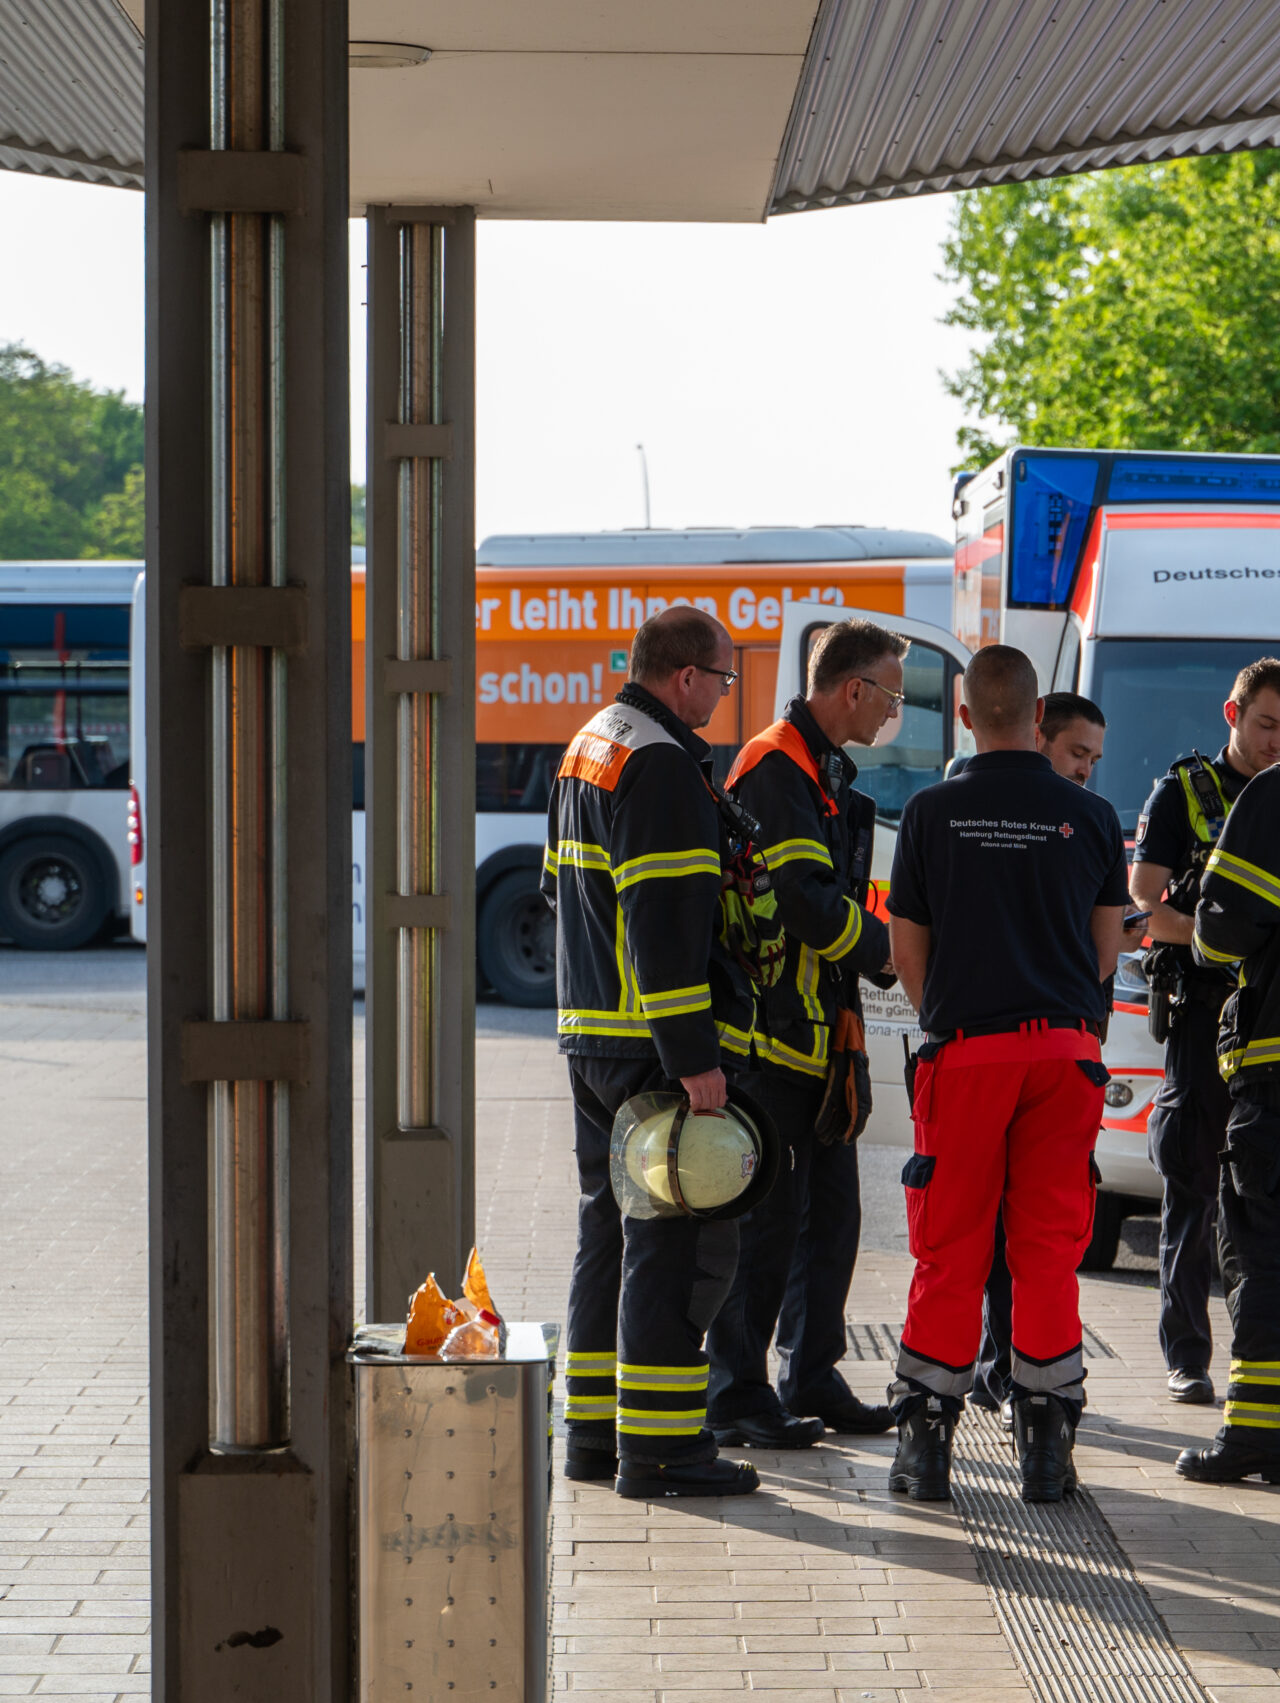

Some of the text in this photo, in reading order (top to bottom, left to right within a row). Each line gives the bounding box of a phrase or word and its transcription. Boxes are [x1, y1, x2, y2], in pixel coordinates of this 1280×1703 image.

[510, 588, 597, 630] leiht
[479, 663, 603, 704] schon!
[950, 819, 1057, 832] Deutsches Rotes Kreuz
[959, 831, 1047, 842] Hamburg Rettungsdienst
